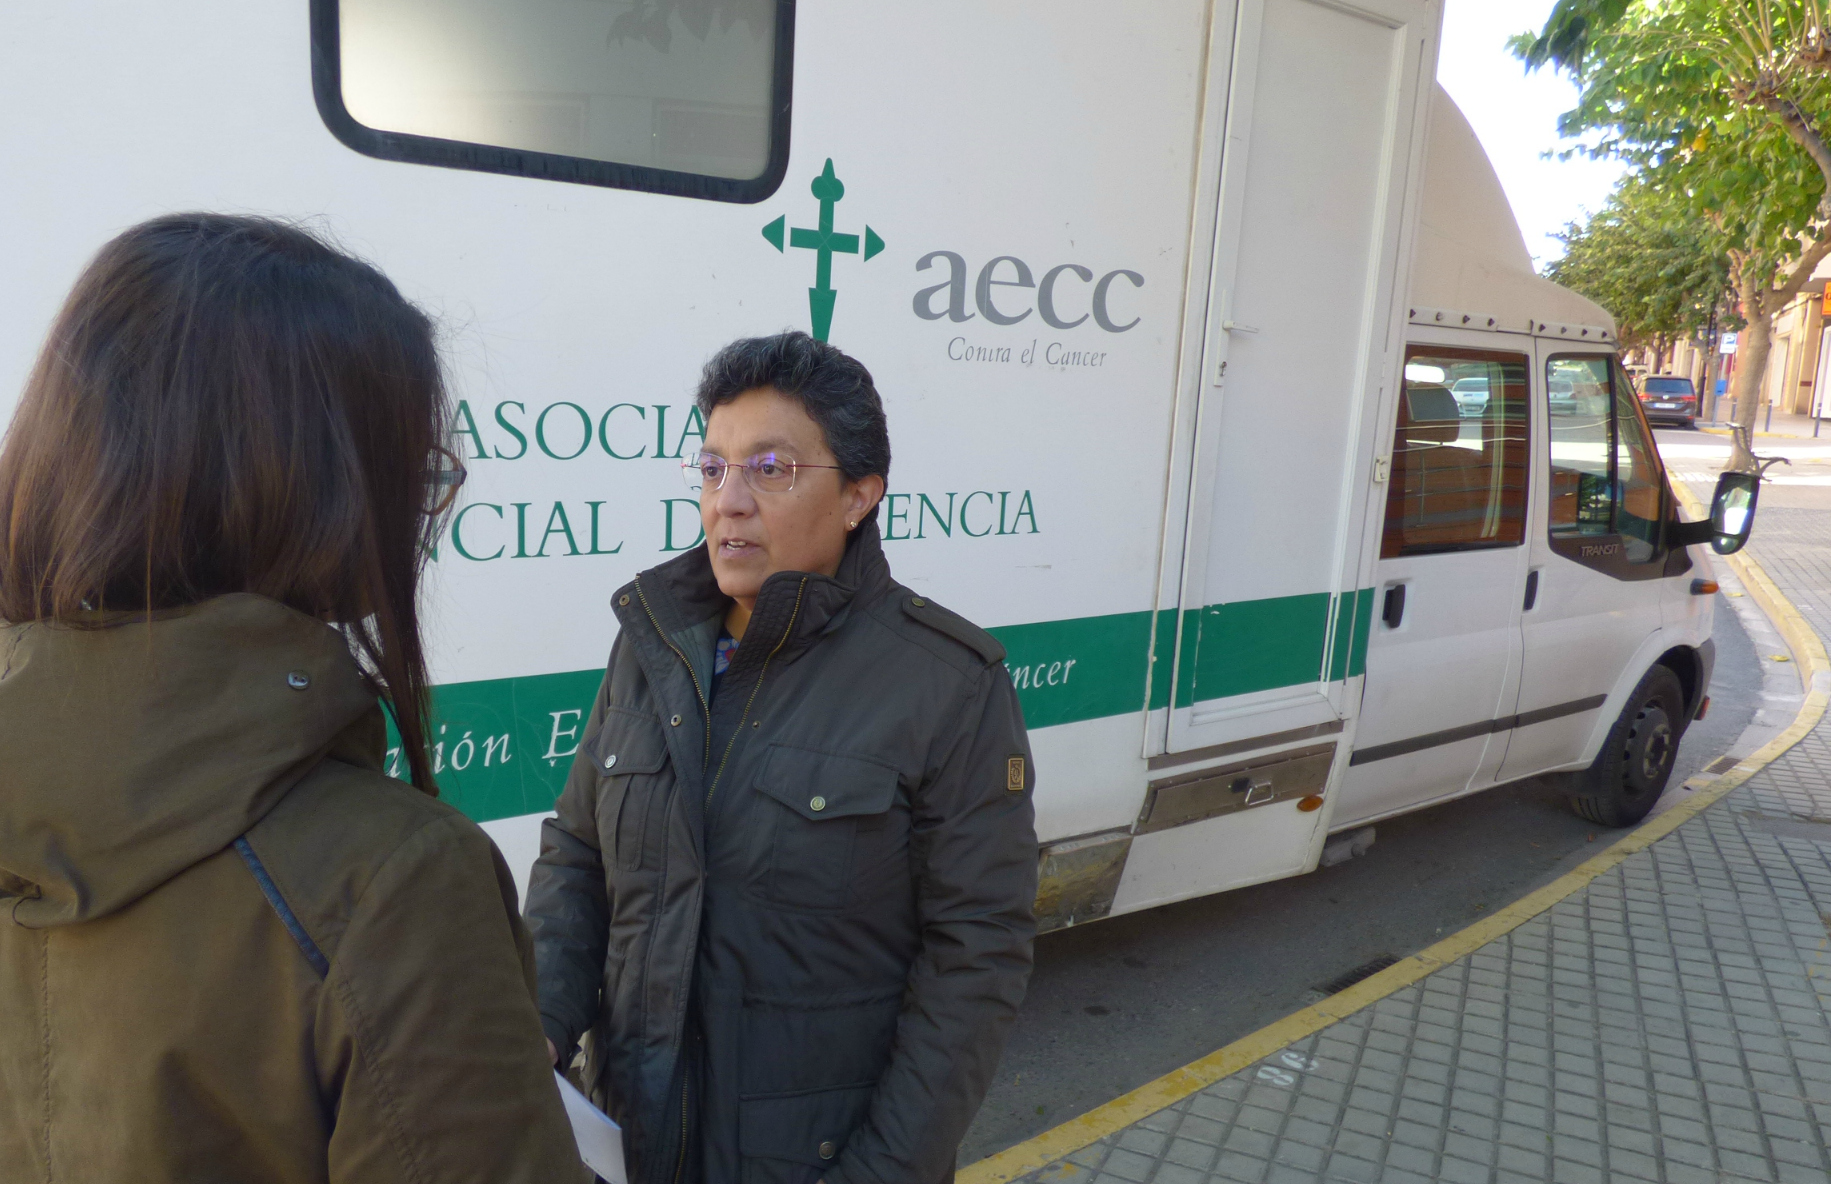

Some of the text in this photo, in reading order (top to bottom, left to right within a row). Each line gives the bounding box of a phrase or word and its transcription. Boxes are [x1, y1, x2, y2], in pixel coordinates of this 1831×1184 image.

[912, 250, 1145, 333] aecc
[947, 336, 1107, 367] Contra el Cancer
[1581, 543, 1619, 557] TRANSIT
[1004, 659, 1077, 690] ncer
